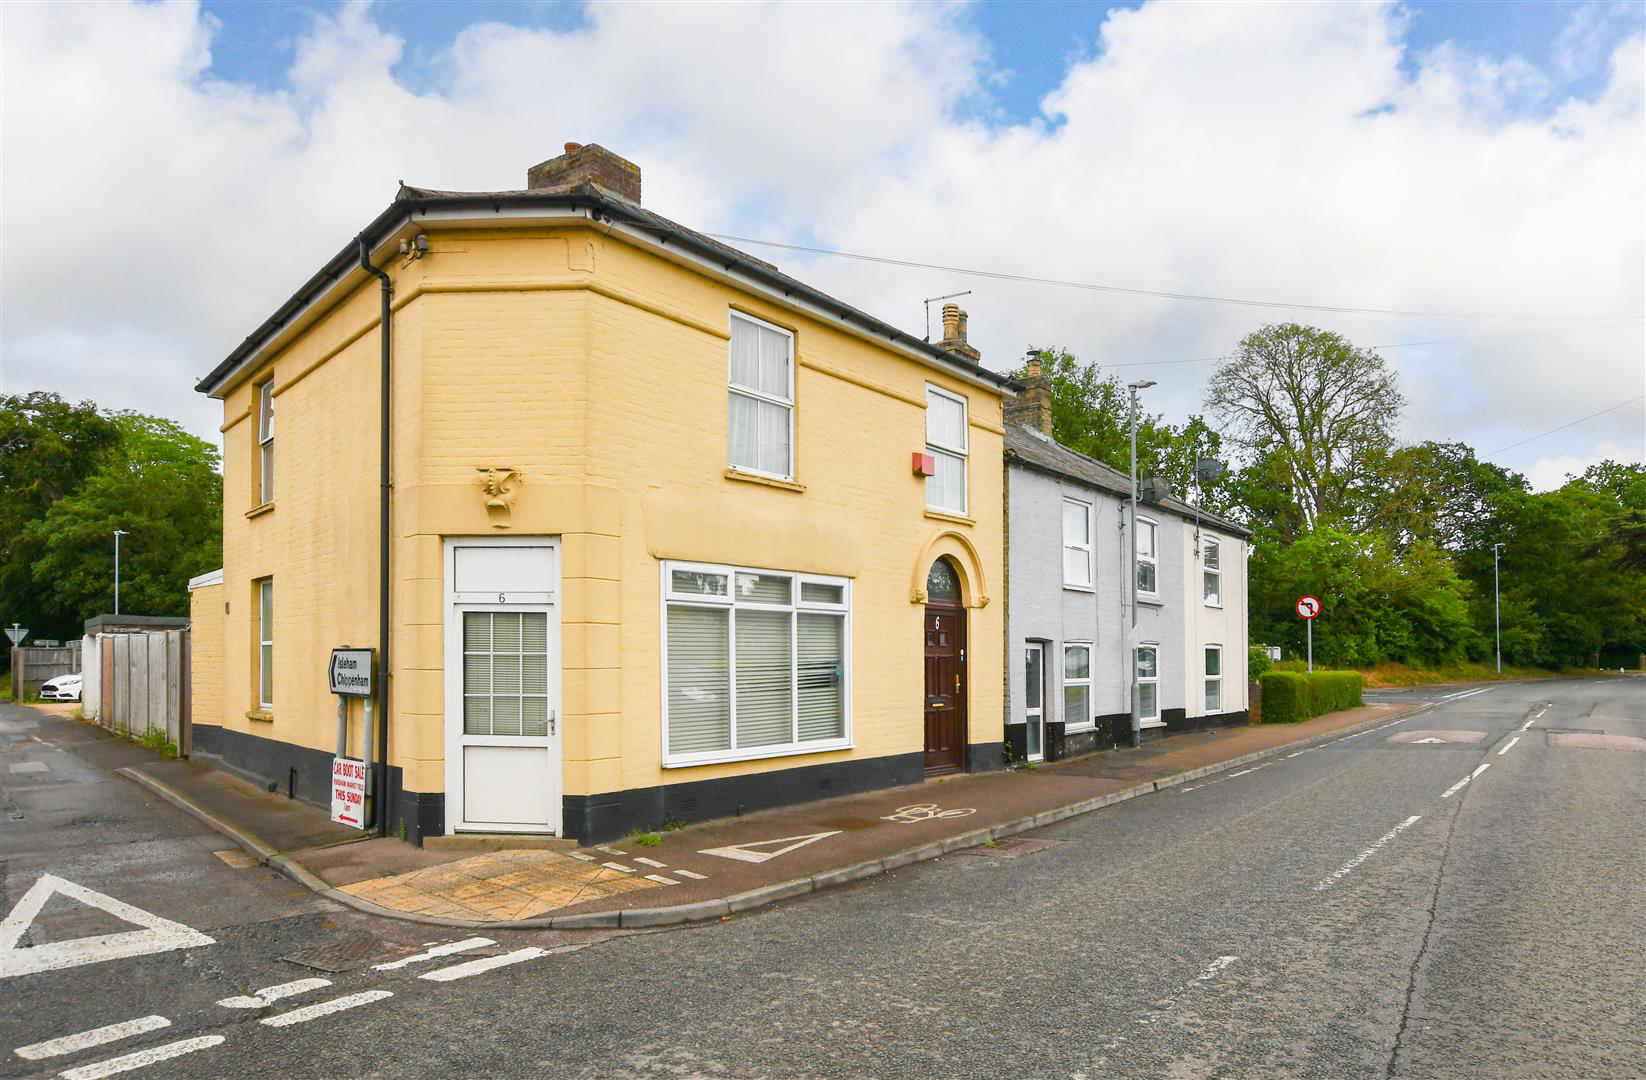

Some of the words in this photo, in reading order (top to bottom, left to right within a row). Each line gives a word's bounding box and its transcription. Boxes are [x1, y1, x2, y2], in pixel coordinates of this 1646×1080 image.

[499, 592, 505, 602] 6
[935, 616, 940, 630] 6
[338, 656, 357, 669] Isleham
[337, 672, 369, 688] Chippenham
[334, 761, 342, 775] CAR
[343, 763, 353, 777] BOOT
[355, 765, 364, 780] SALE
[335, 789, 345, 801] THIS
[347, 791, 362, 805] SUNDAY
